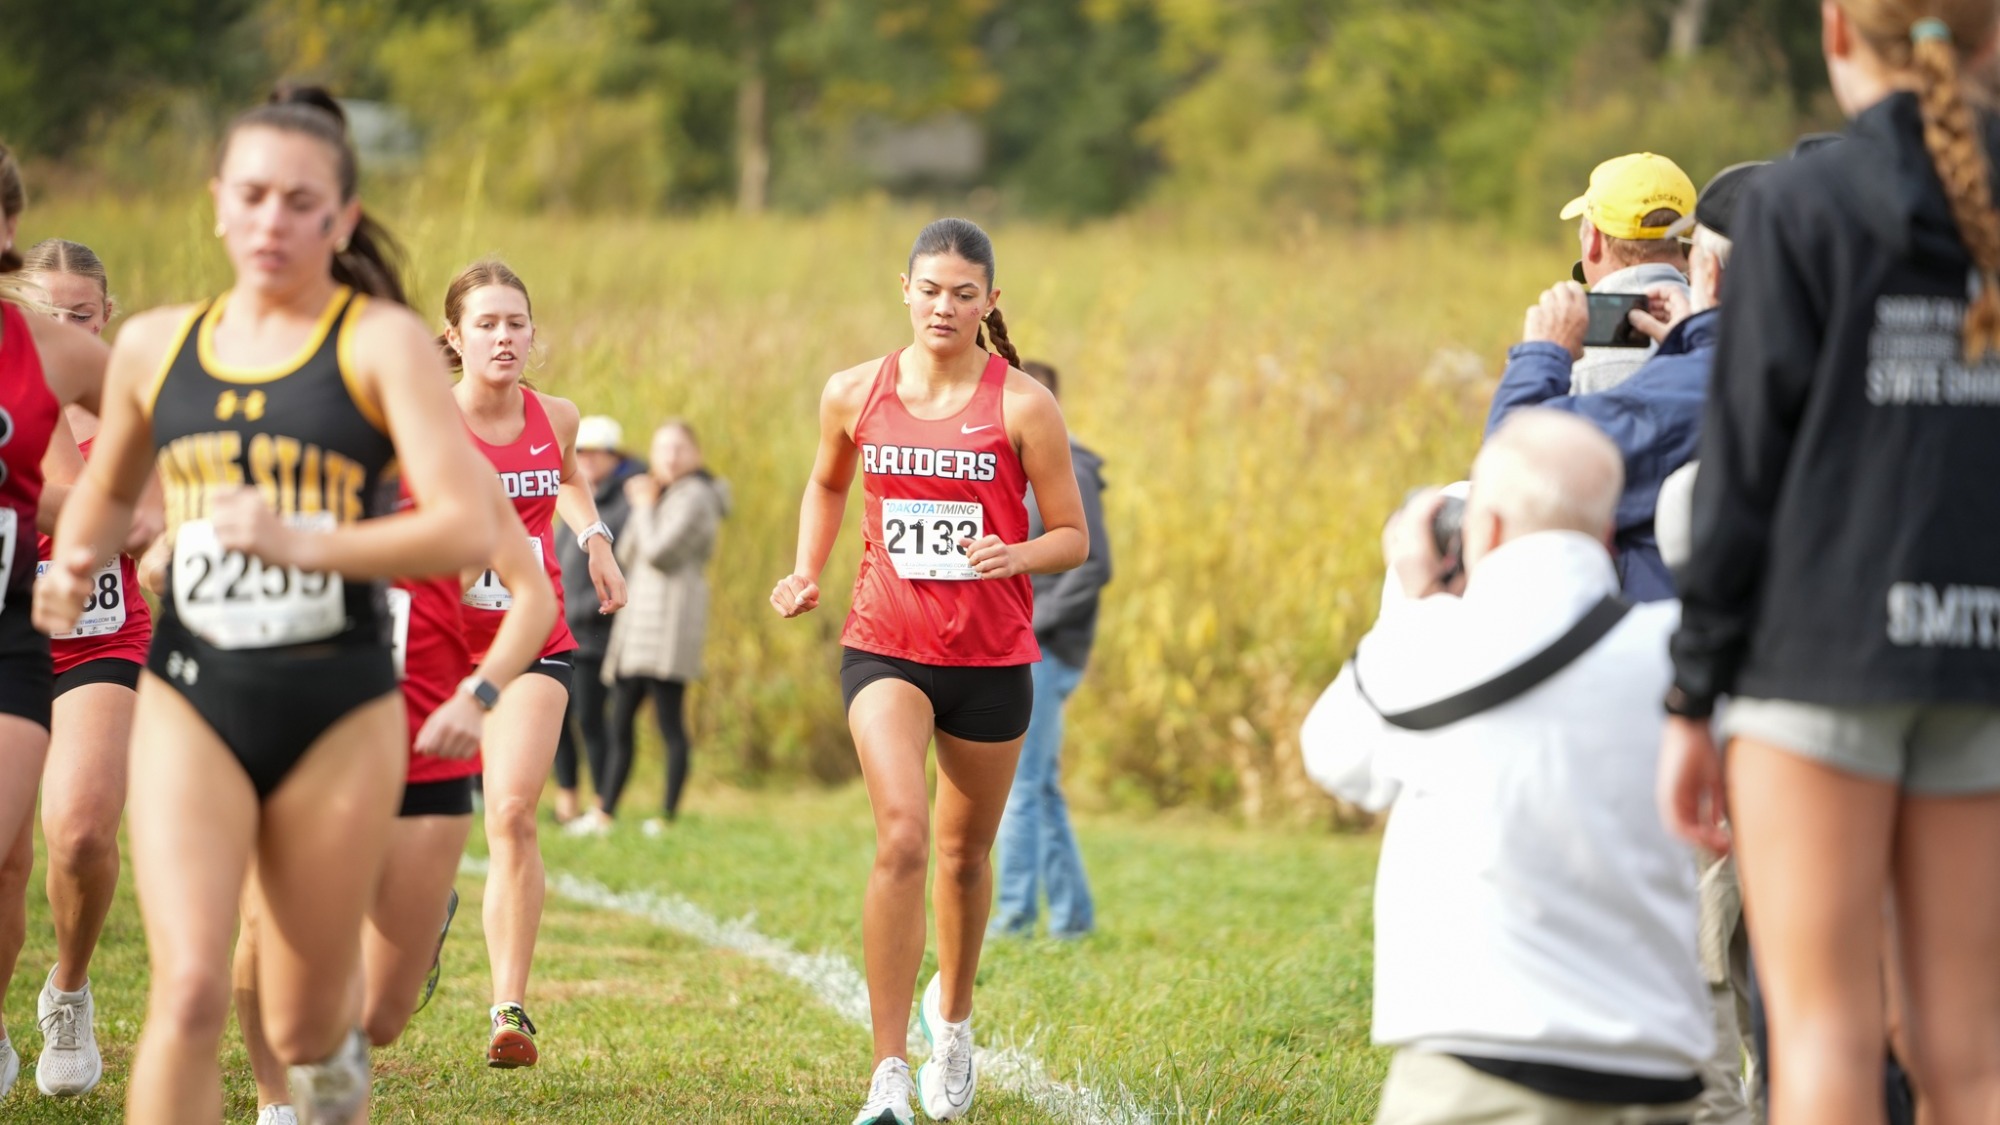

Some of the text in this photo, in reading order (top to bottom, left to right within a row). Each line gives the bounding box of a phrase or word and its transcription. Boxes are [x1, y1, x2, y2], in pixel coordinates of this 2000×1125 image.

[248, 432, 366, 525] STATE
[862, 443, 997, 481] RAIDERS
[497, 469, 561, 498] DERS
[885, 518, 978, 556] 2133
[1886, 582, 2000, 649] SMIT
